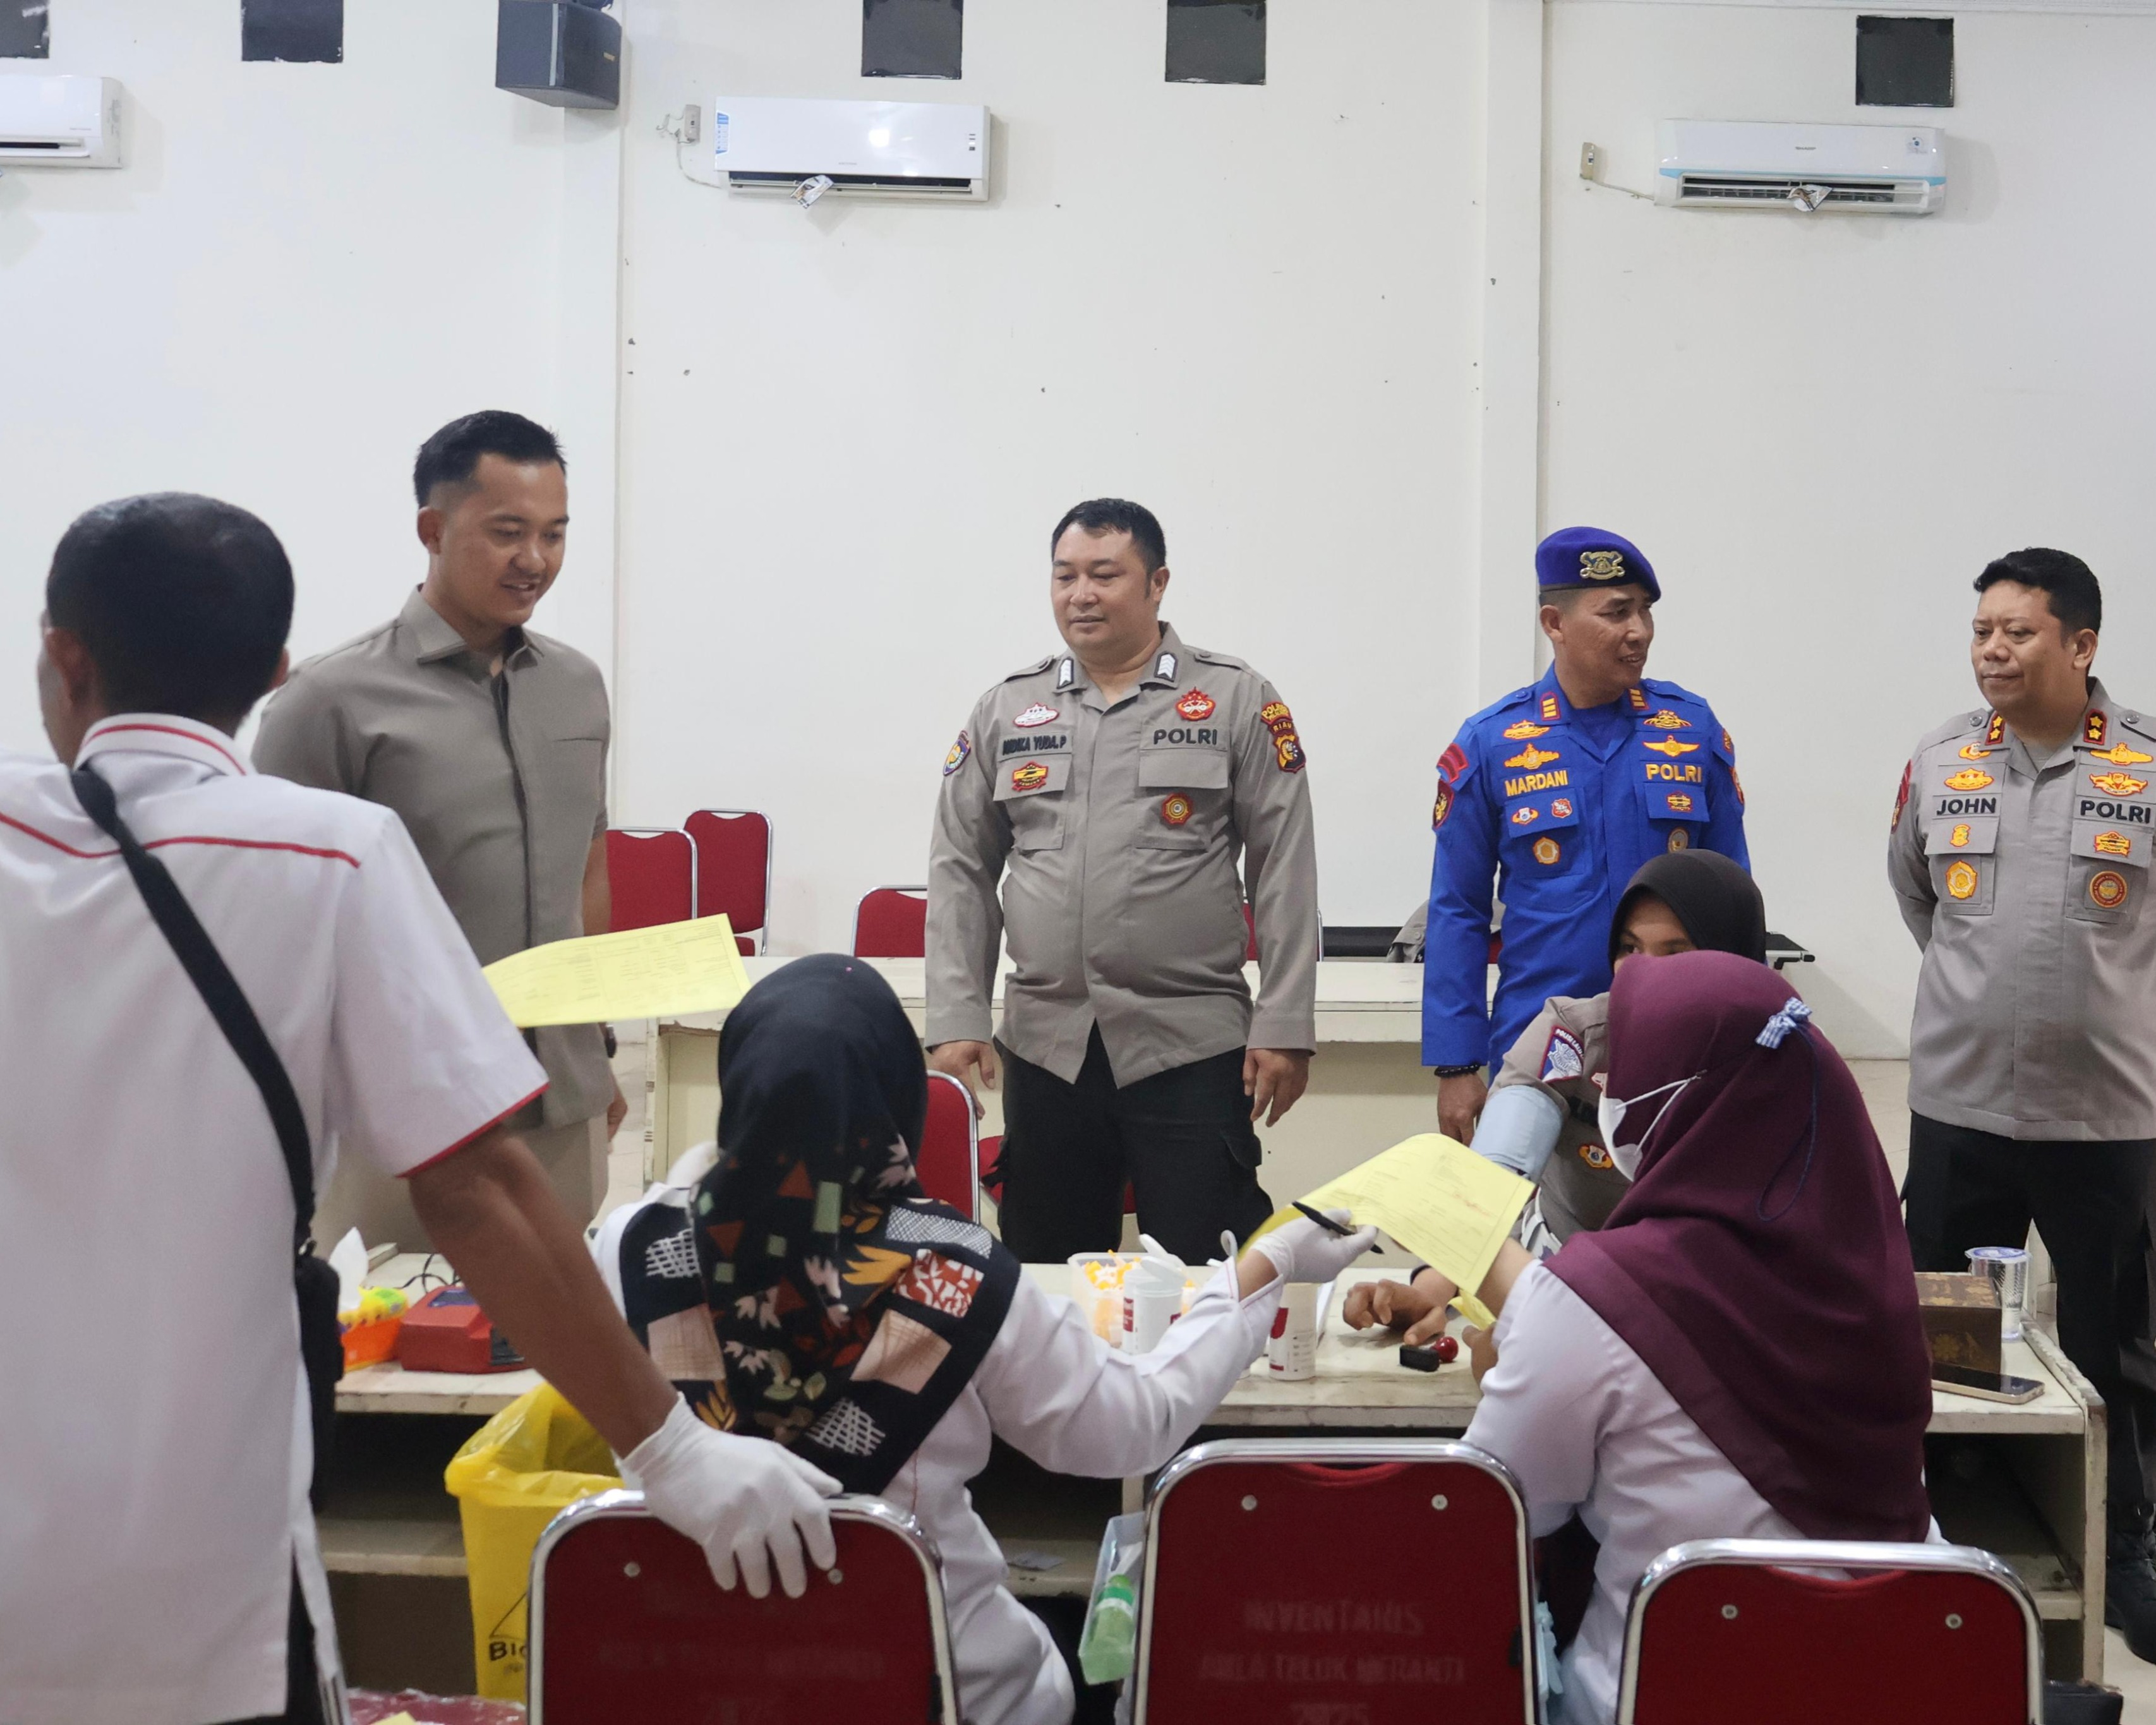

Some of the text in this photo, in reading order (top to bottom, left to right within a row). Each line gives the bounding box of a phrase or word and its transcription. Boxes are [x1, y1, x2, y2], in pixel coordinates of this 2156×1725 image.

[1153, 728, 1218, 746] POLRI
[1504, 769, 1569, 797] MARDANI
[1646, 764, 1702, 783] POLRI
[1936, 797, 1997, 815] JOHN
[2080, 799, 2151, 824] POLRI
